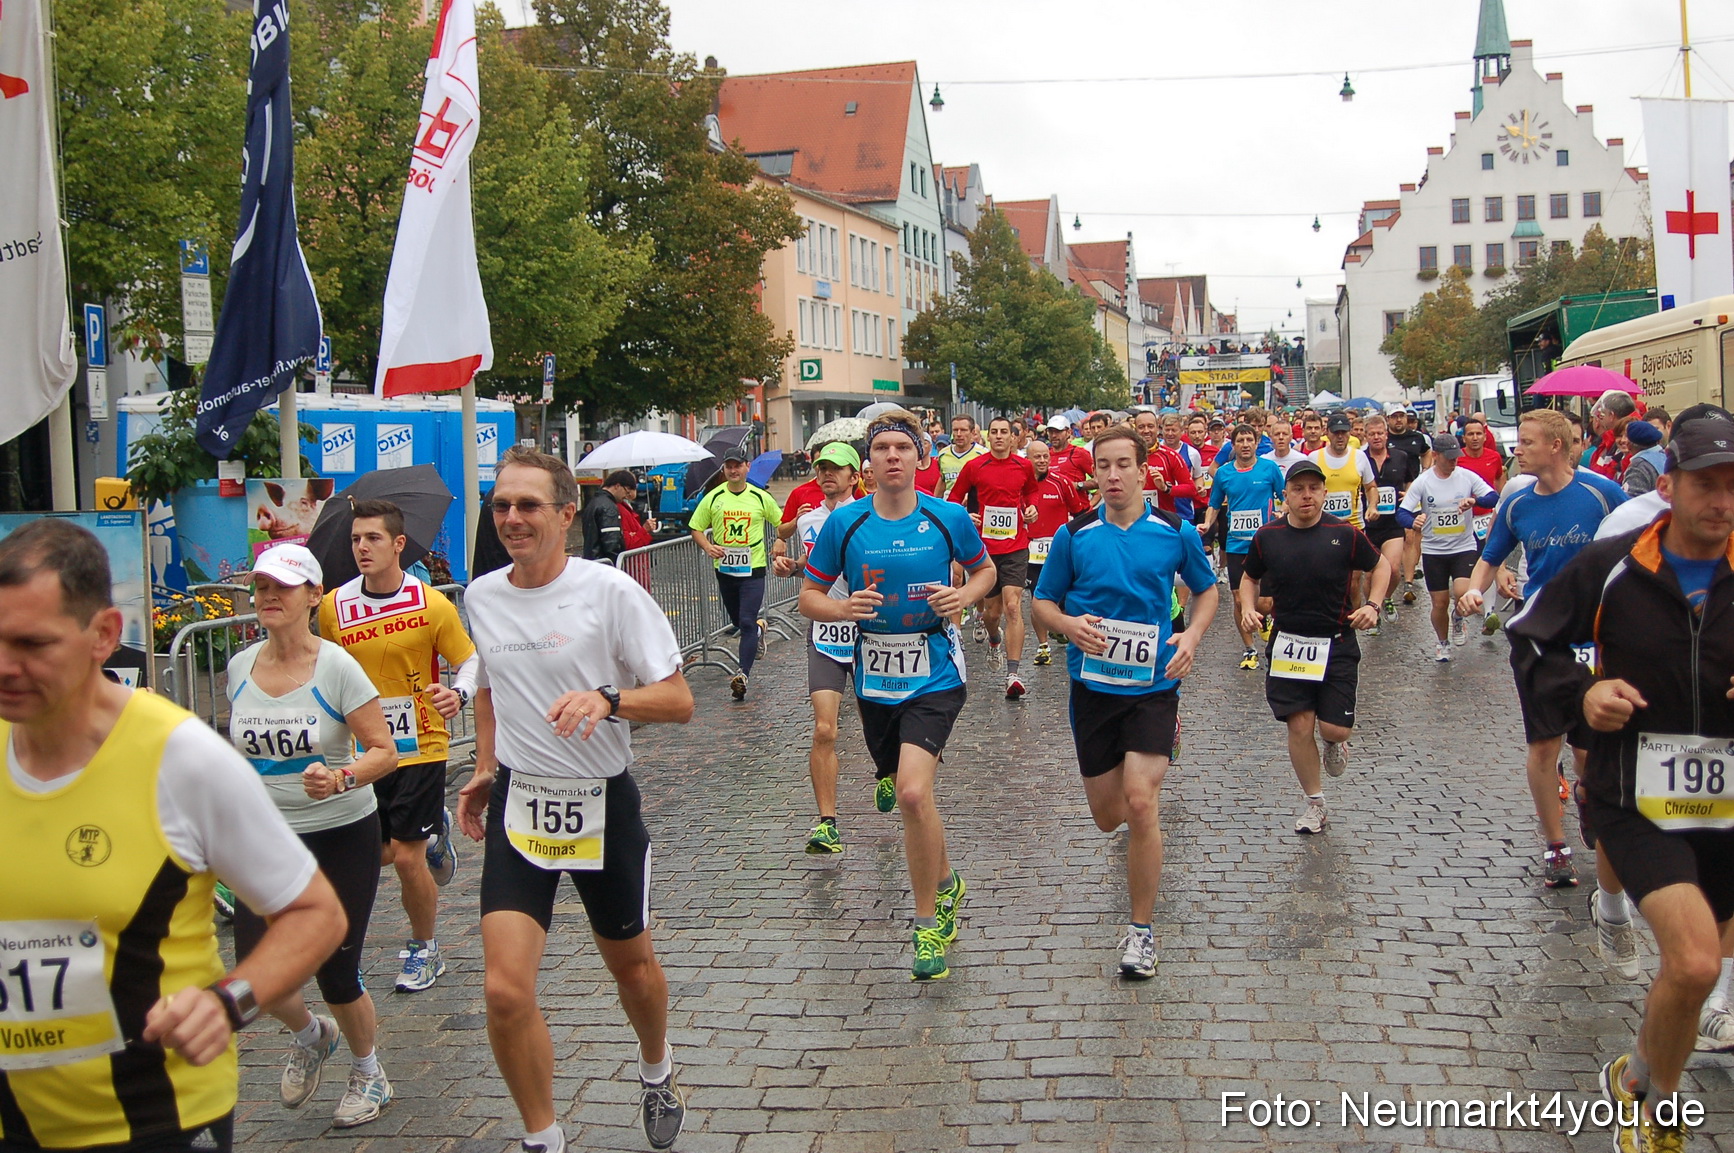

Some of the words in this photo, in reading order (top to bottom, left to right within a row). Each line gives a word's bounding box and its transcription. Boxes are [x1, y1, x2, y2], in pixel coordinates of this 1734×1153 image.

[89, 313, 100, 358] P
[1642, 347, 1693, 376] Bayerisches
[803, 362, 819, 378] D
[1208, 372, 1239, 381] START
[1642, 378, 1666, 397] Rotes
[1324, 499, 1349, 510] 2873
[1378, 494, 1394, 503] 48
[990, 515, 1012, 528] 390
[1233, 517, 1260, 529] 2708
[1438, 514, 1459, 526] 528
[729, 524, 744, 537] M
[722, 554, 748, 566] 2070
[341, 627, 379, 647] MAX
[384, 616, 430, 635] BÖGL
[1112, 627, 1146, 637] Neumarkt
[503, 642, 556, 653] FEDDERSEN
[824, 647, 854, 656] Bernhar
[1095, 636, 1150, 664] 716
[1283, 643, 1318, 661] 470
[868, 649, 922, 674] 2717
[1101, 664, 1134, 679] Ludwig
[1289, 665, 1306, 673] Jens
[881, 679, 909, 689] Adrian
[238, 717, 263, 726] PARTL
[264, 717, 303, 726] Neumarkt
[243, 729, 314, 757] 3164
[1640, 742, 1676, 753] PARTL
[1680, 744, 1724, 755] Neumarkt
[1660, 756, 1725, 794] 198
[511, 780, 538, 793] PARTL
[540, 786, 587, 796] Neumarkt
[1665, 801, 1714, 815] Christof
[526, 798, 584, 834] 155
[79, 828, 99, 840] MTP
[527, 839, 576, 856] Thomas
[0, 935, 73, 950] Neumarkt
[1, 1028, 65, 1049] Volker
